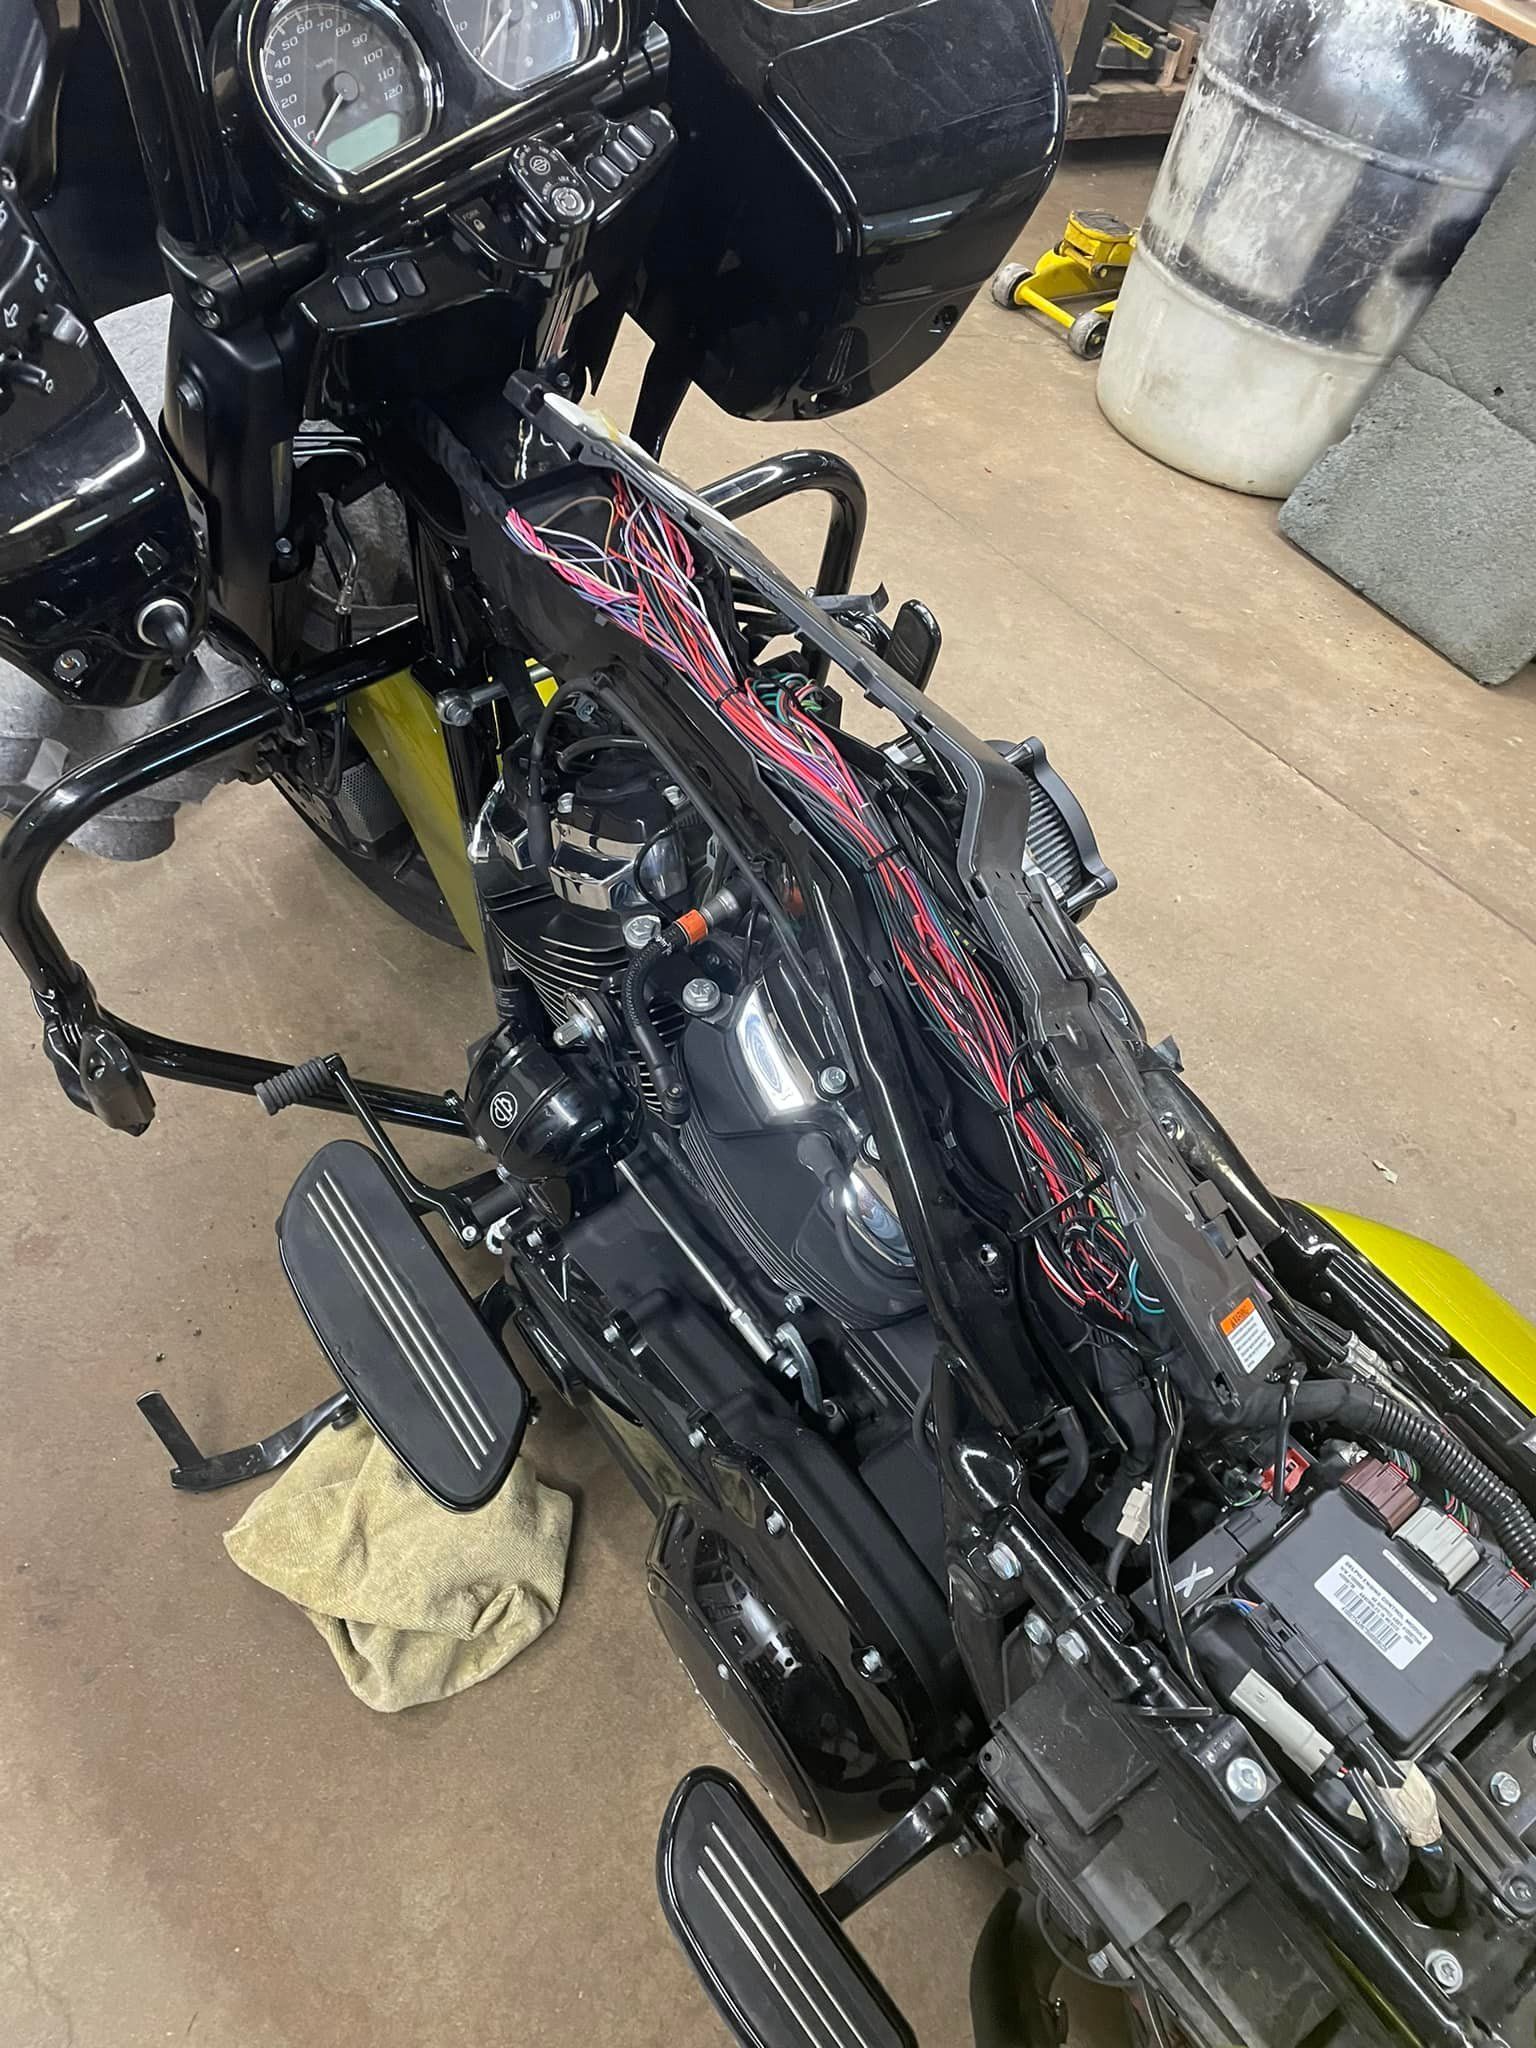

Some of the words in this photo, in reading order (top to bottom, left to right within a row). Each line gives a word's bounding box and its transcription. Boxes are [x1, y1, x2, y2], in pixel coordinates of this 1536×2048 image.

[546, 10, 561, 23] 80
[296, 19, 313, 34] 60
[317, 18, 333, 32] 70
[335, 23, 351, 37] 80
[281, 36, 298, 50] 50
[352, 33, 368, 47] 90
[274, 55, 291, 69] 40
[363, 48, 383, 65] 100
[275, 73, 292, 88] 30
[377, 67, 395, 83] 110
[384, 84, 403, 101] 120
[280, 93, 297, 109] 20
[292, 114, 306, 128] 10
[307, 130, 316, 141] 0
